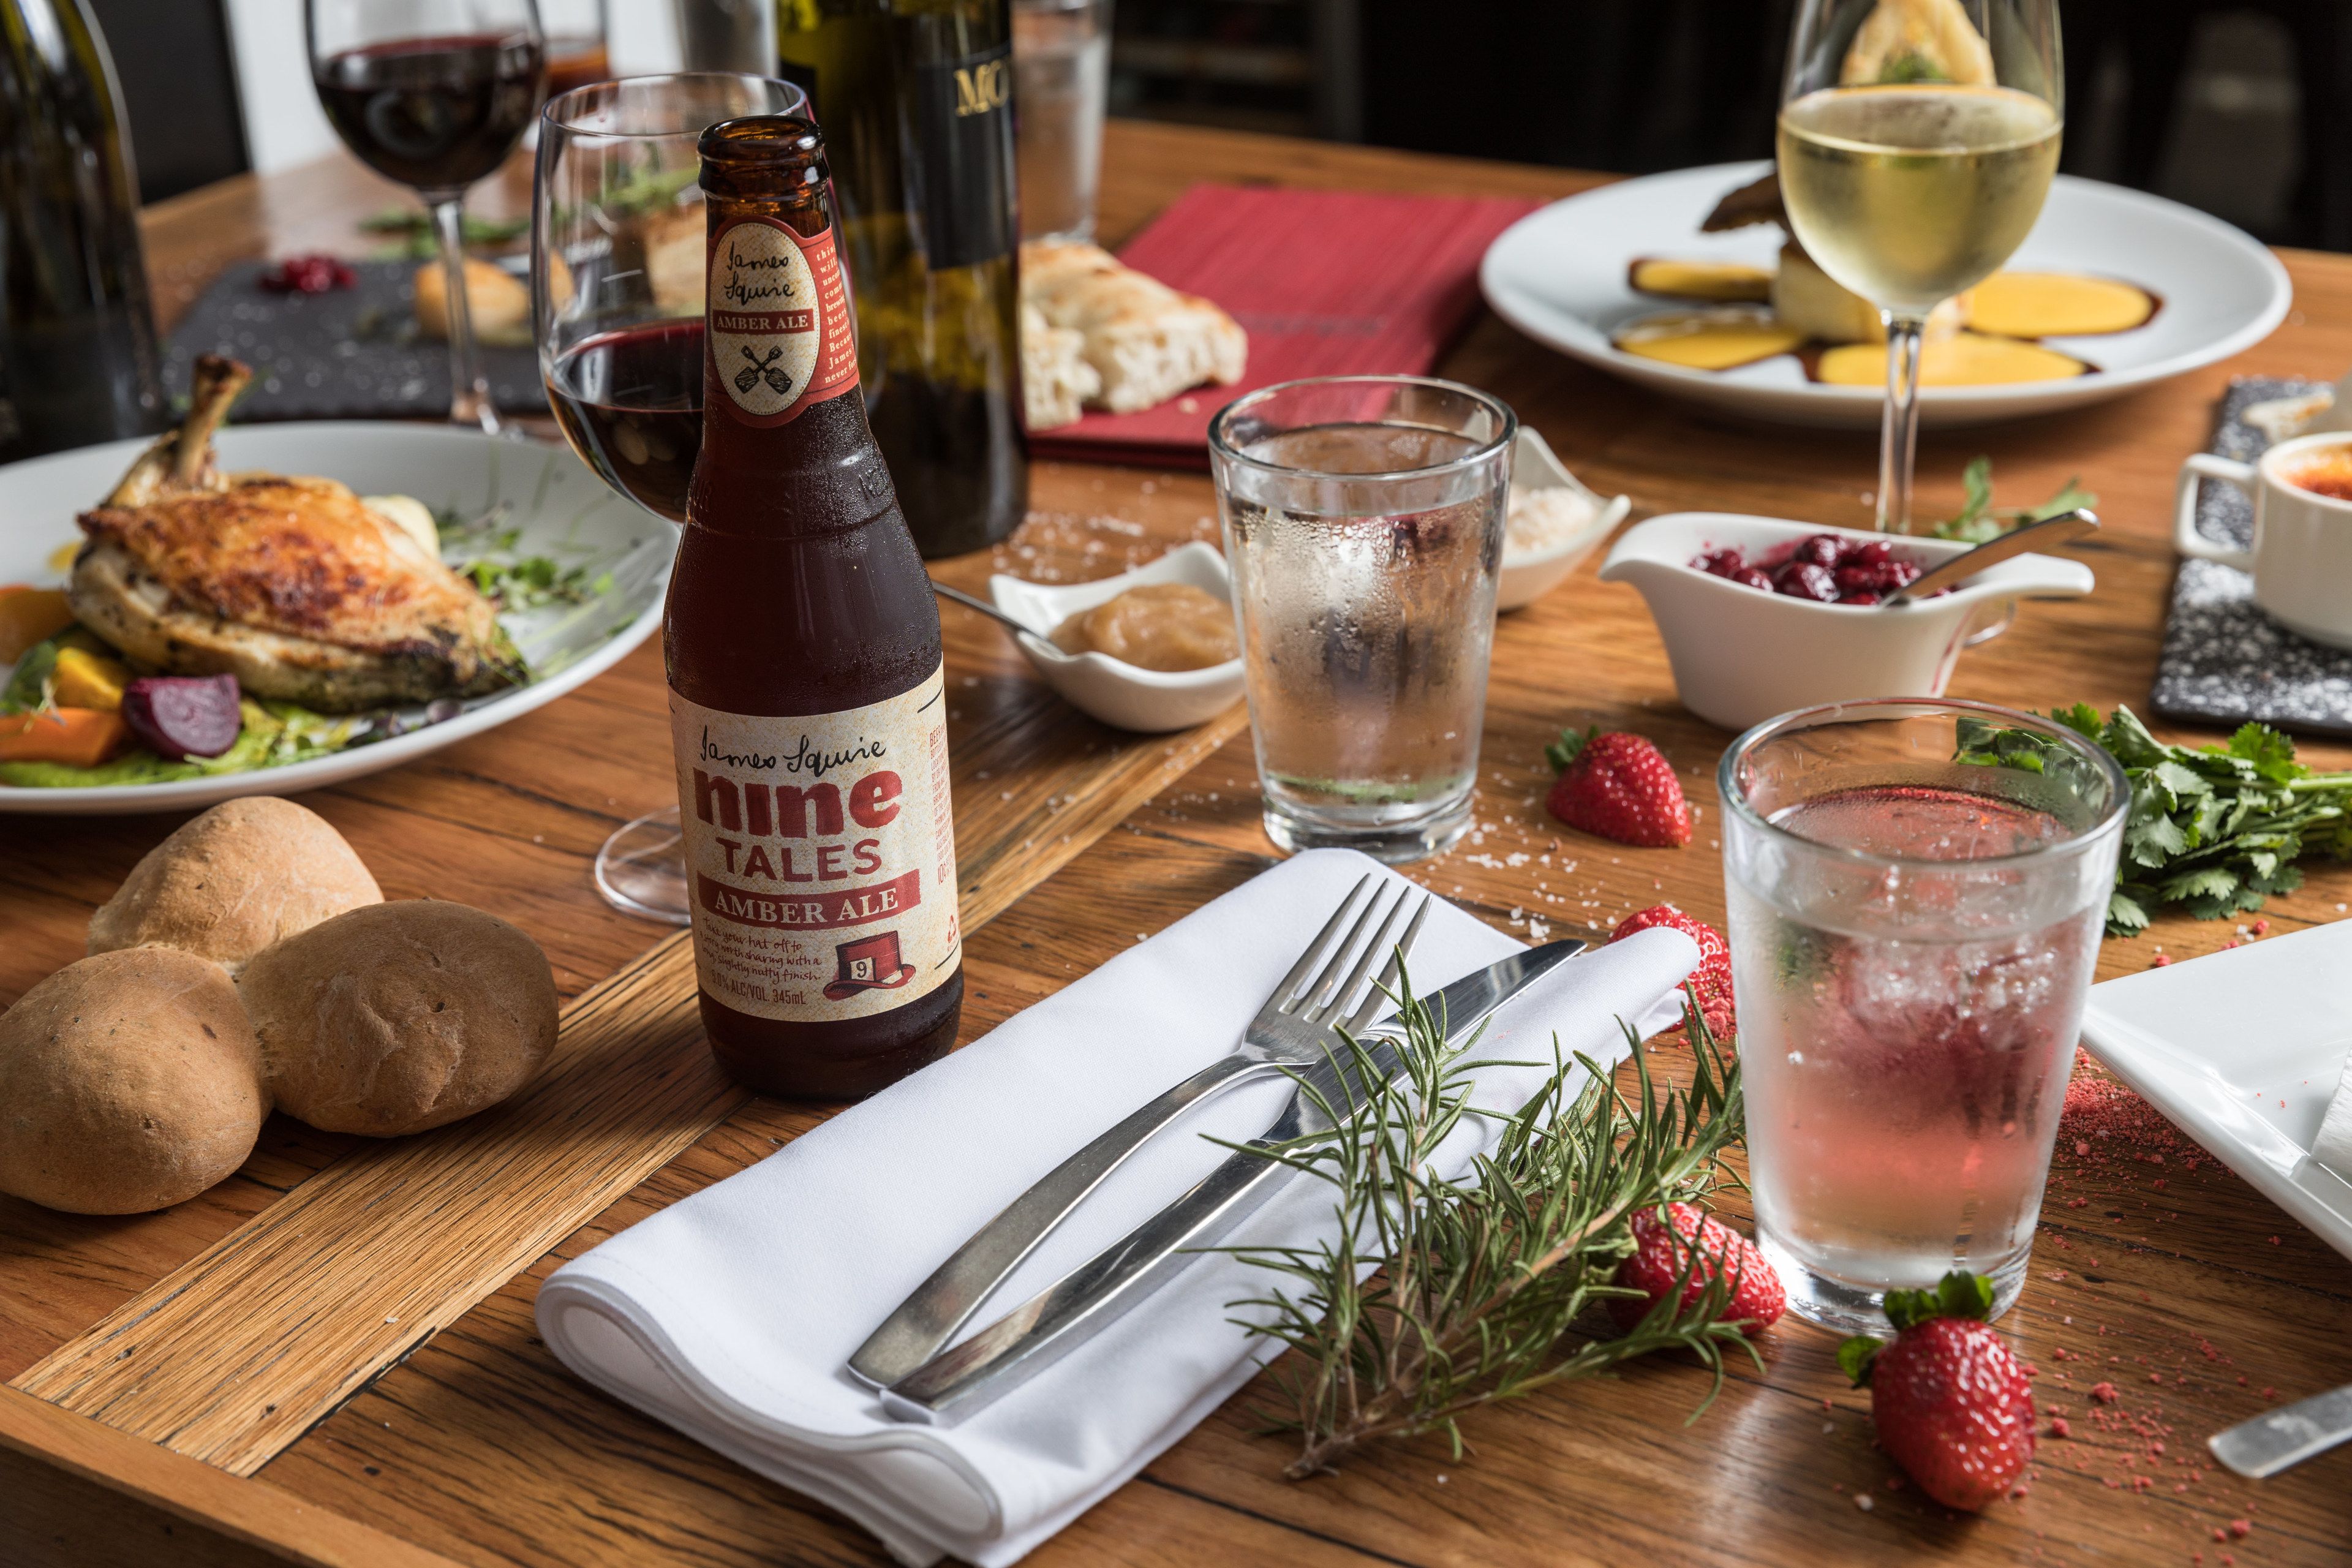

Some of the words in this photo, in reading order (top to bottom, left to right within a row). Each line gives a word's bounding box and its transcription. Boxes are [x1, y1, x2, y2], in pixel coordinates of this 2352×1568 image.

[726, 240, 789, 271] James
[723, 271, 795, 306] Squire
[717, 315, 771, 331] AMBER
[775, 314, 809, 330] ALE
[827, 307, 846, 325] beers
[829, 348, 852, 370] James
[824, 366, 847, 383] never
[699, 724, 776, 769] James
[783, 734, 887, 777] Squire
[693, 767, 903, 839] nine
[715, 837, 882, 883] TALES
[714, 891, 827, 924] AMBER
[837, 887, 899, 921] ALE
[723, 932, 746, 944] your
[748, 935, 772, 949] hat
[774, 938, 791, 953] off
[791, 941, 802, 953] to
[720, 943, 744, 958] worth
[744, 950, 783, 969] sharing
[786, 955, 811, 966] with
[813, 956, 822, 966] a
[752, 967, 780, 985] nutty
[855, 960, 868, 979] 9
[772, 989, 807, 1005] 345mL
